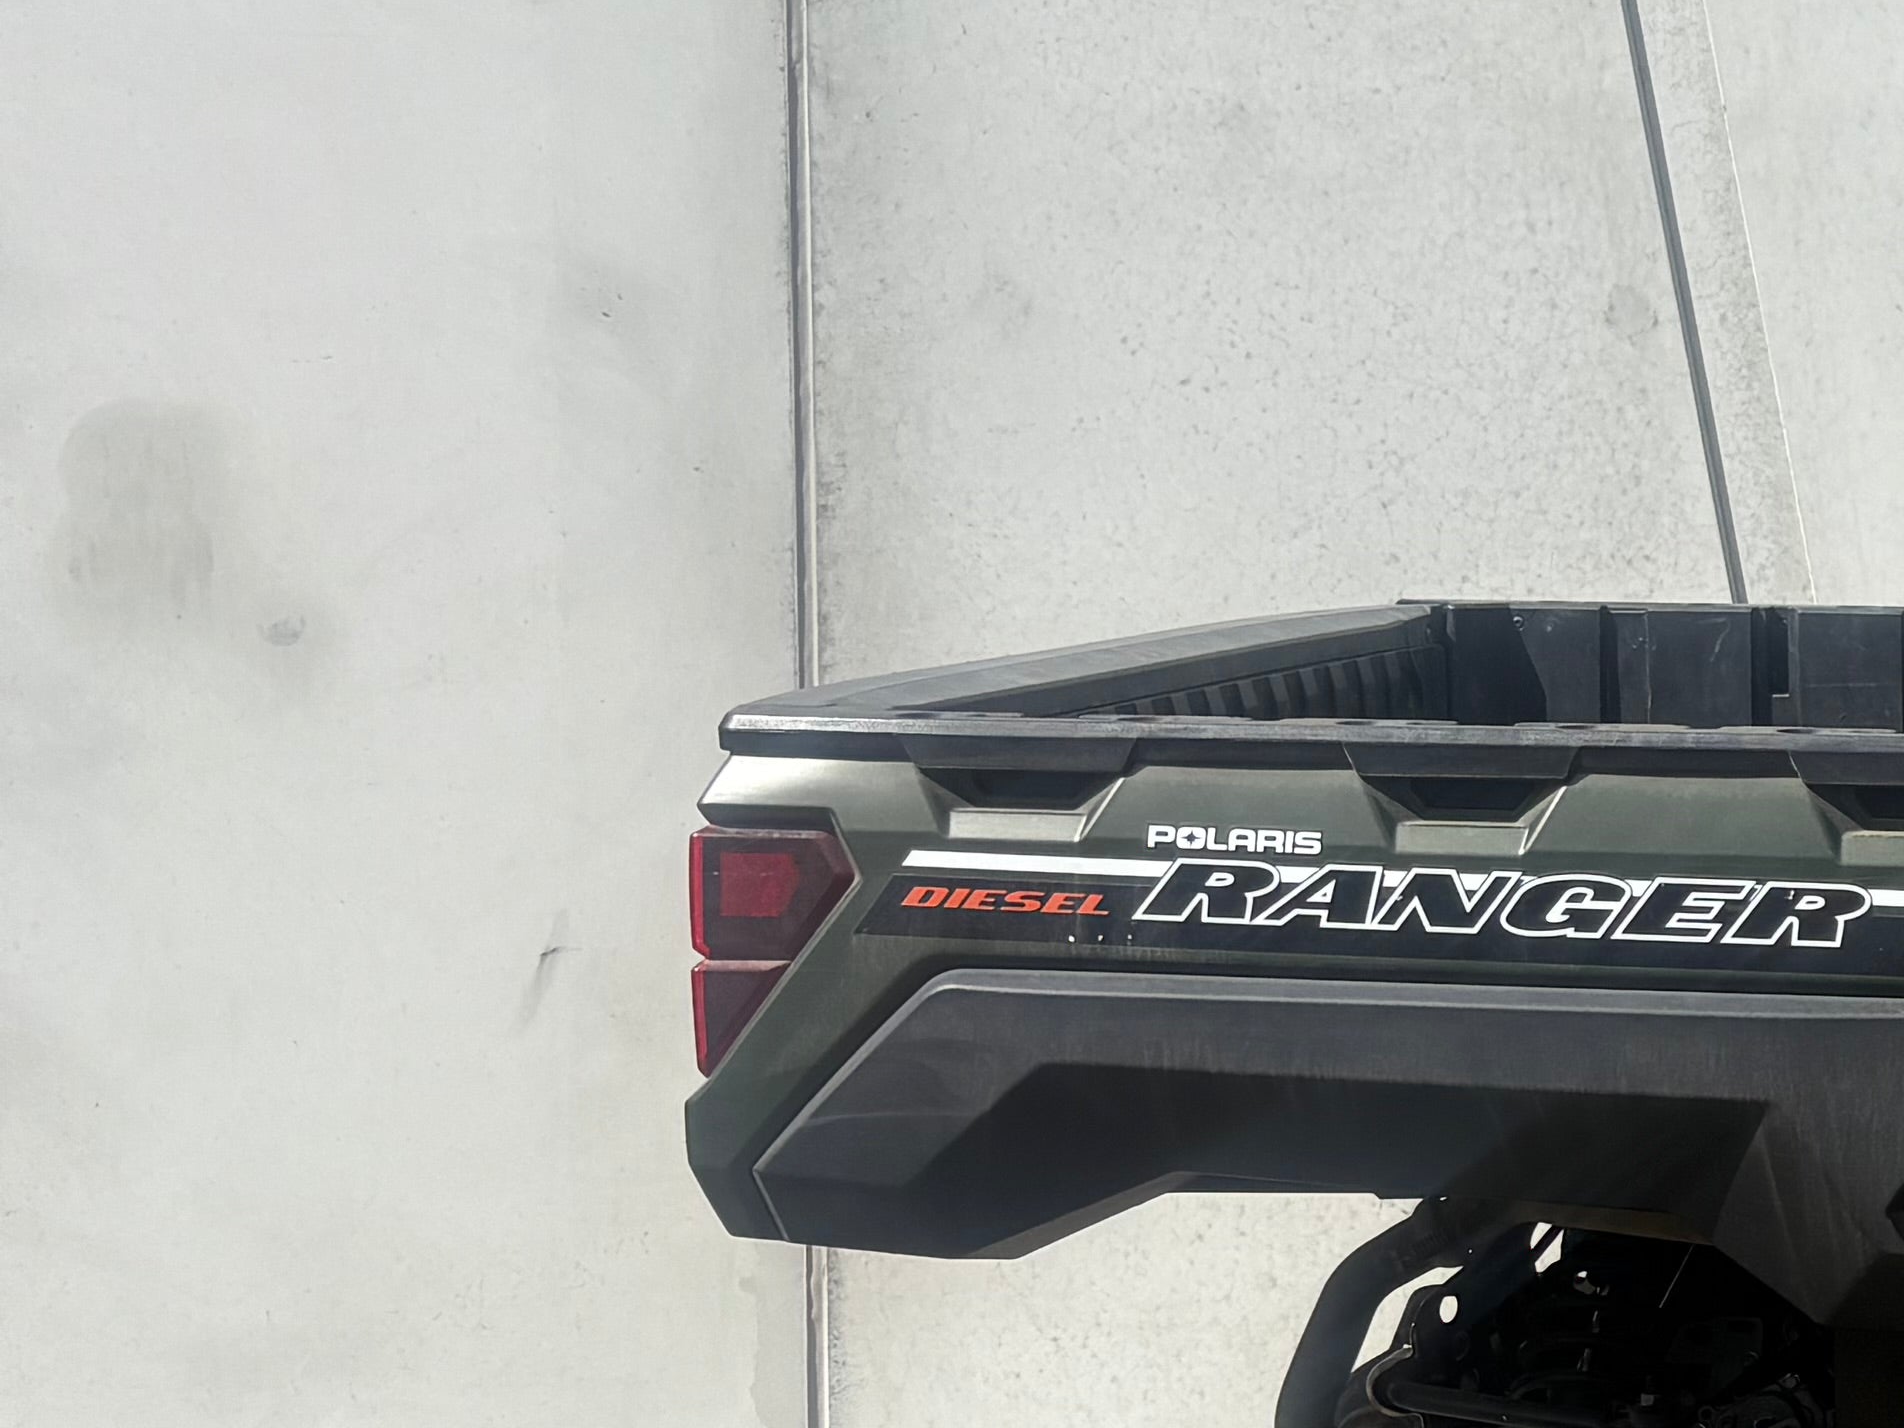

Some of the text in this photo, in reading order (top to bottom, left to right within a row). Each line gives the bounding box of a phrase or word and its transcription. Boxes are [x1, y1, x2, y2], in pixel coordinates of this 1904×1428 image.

[1147, 824, 1322, 854] POLARIS
[901, 886, 1110, 916] DIESEL
[1131, 858, 1873, 948] RANGER
